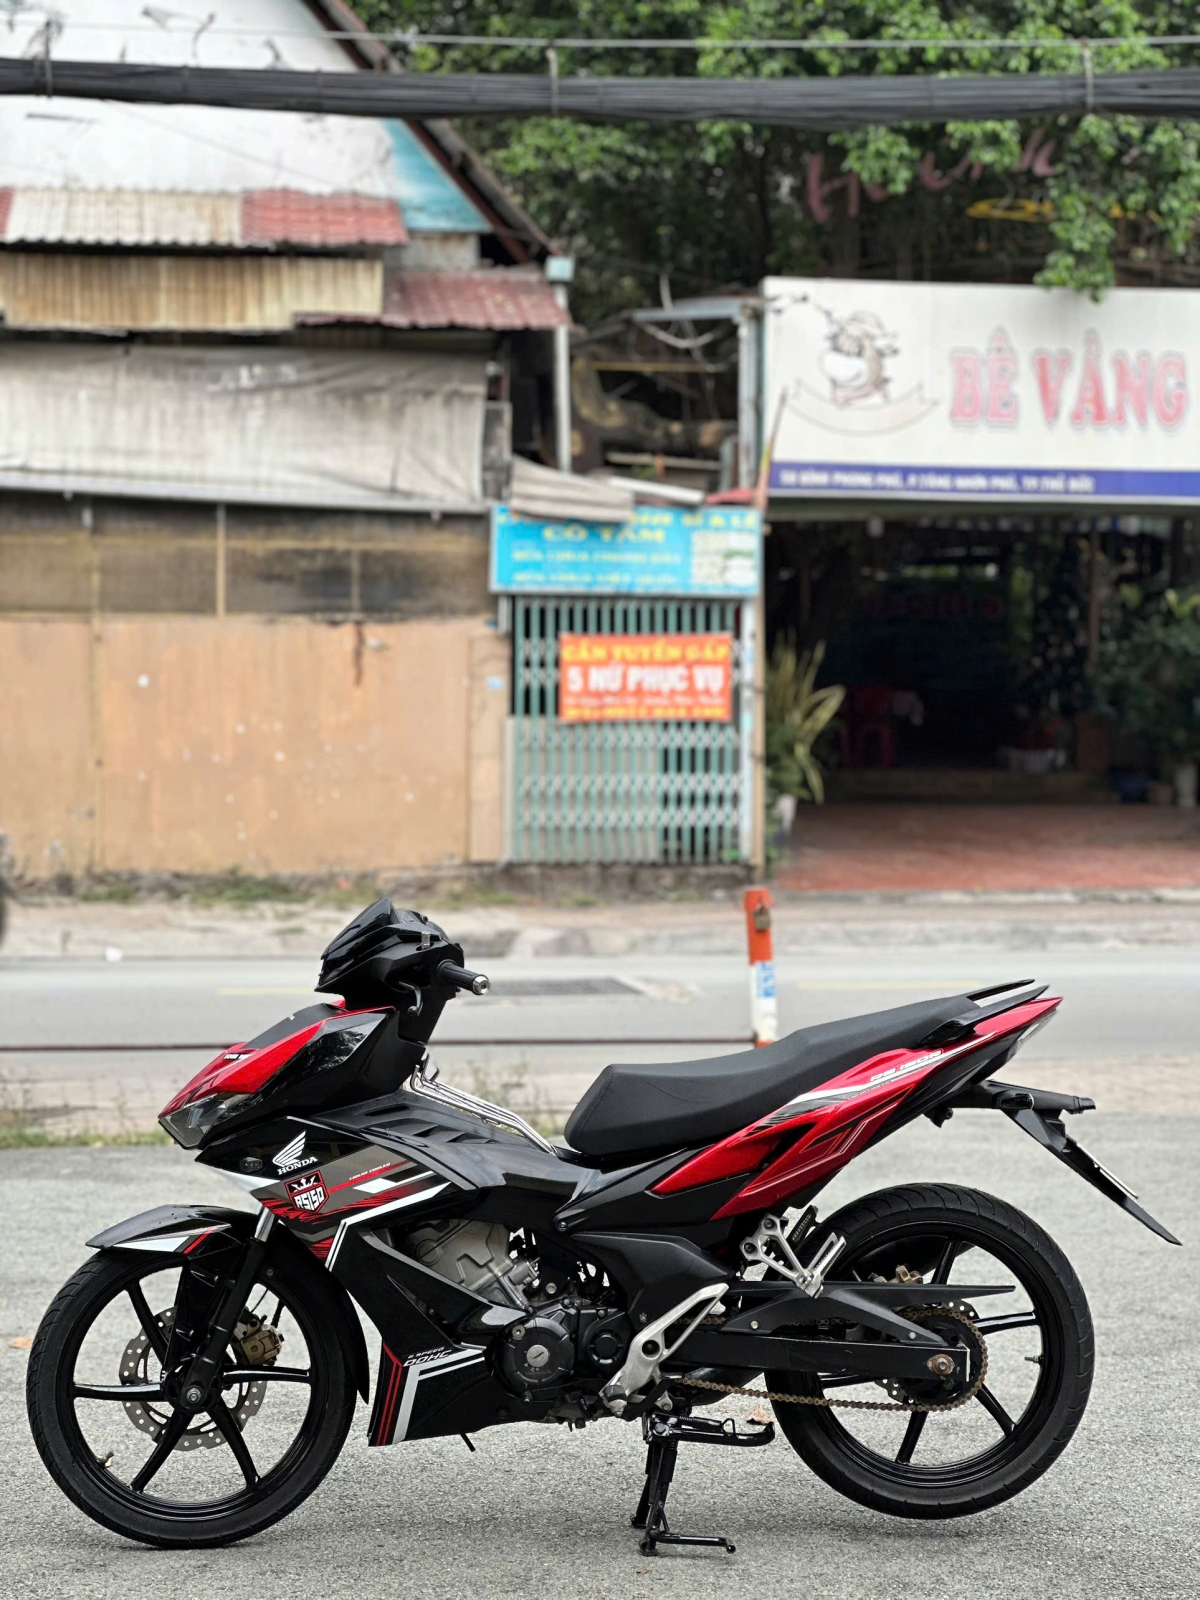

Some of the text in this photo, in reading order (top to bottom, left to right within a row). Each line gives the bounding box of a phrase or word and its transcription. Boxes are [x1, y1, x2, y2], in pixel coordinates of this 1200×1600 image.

[277, 1156, 318, 1176] HONDA
[293, 1186, 325, 1211] RS150
[403, 1349, 452, 1367] DOHC
